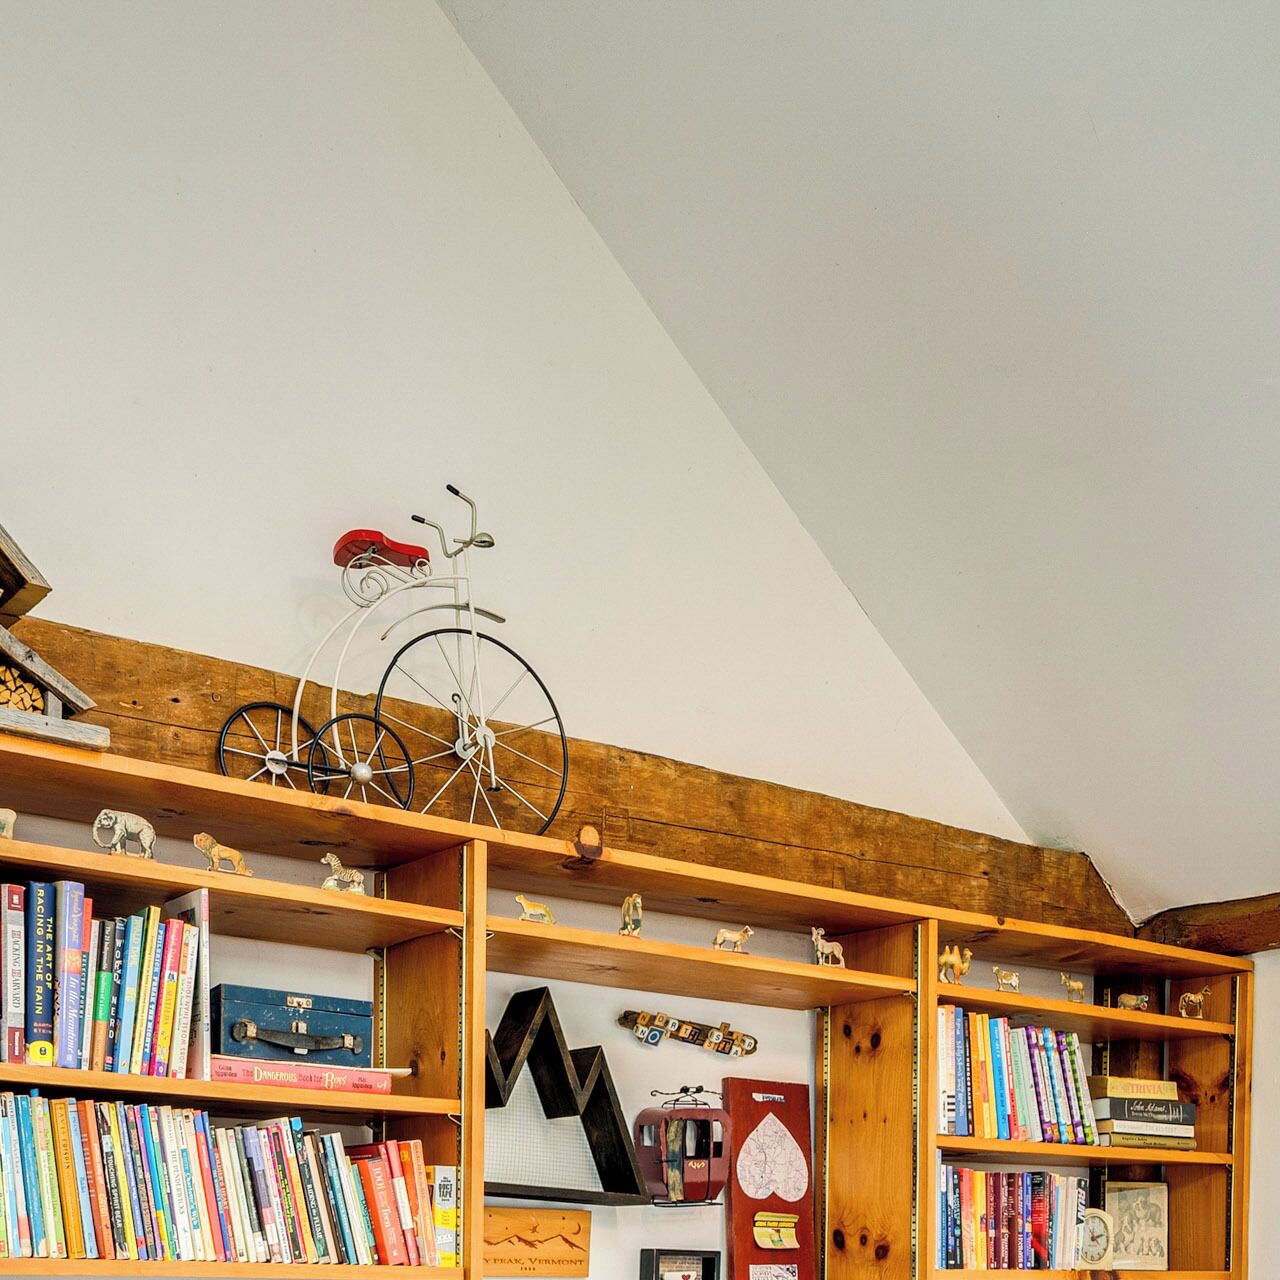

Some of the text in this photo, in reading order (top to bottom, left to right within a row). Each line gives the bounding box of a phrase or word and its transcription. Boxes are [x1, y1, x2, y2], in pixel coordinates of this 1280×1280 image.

[36, 889, 44, 935] RACING
[36, 940, 43, 953] IN
[45, 917, 53, 989] THE ART OF
[153, 929, 163, 972] PHILBRICK
[12, 930, 21, 1008] HACKING HARVARD
[35, 984, 43, 1014] RAIN
[150, 976, 158, 1002] FREAK
[67, 977, 77, 1054] In the Meantime
[109, 996, 117, 1038] NERD
[163, 990, 174, 1025] MATILDA
[183, 999, 191, 1017] THAN
[145, 1022, 153, 1054] MIGHTY
[181, 1018, 189, 1044] WORSE
[254, 1067, 297, 1082] DANGEROUS
[1129, 1083, 1161, 1093] TRIVIA
[107, 1155, 116, 1187] TOUCHING
[172, 1165, 185, 1215] PENDERWICKS
[307, 1184, 316, 1208] RIDING
[313, 1217, 322, 1240] FLUME
[382, 1207, 392, 1227] Teen
[529, 1257, 584, 1265] VERMONT
